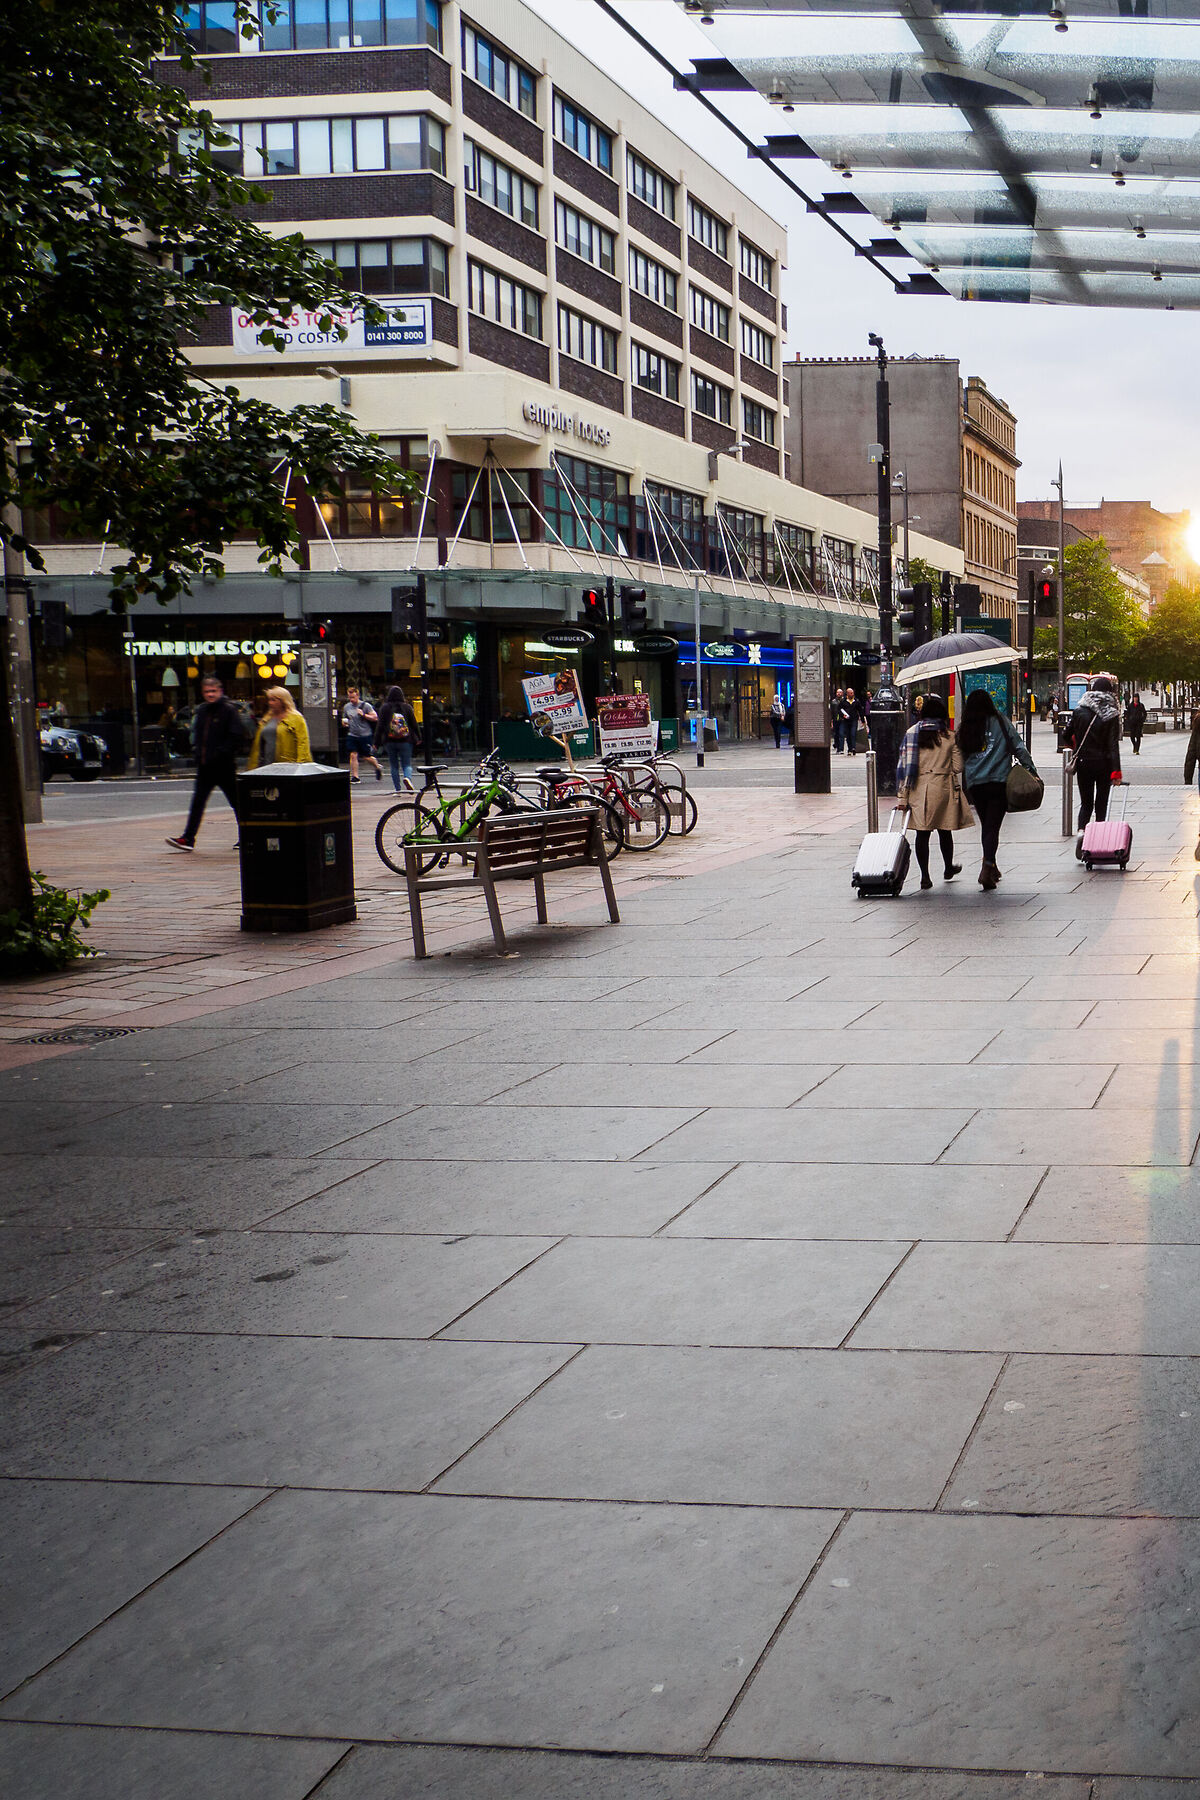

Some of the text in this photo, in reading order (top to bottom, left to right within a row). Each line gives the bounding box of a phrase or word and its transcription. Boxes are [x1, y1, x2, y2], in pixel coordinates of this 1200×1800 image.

[298, 331, 339, 344] COSTS
[367, 331, 424, 341] 0141 300 8000
[523, 401, 611, 447] empire house
[124, 641, 240, 656] STARBUCKS
[529, 678, 545, 689] AGA
[532, 695, 555, 706] £4.99
[550, 707, 572, 718] £5.99
